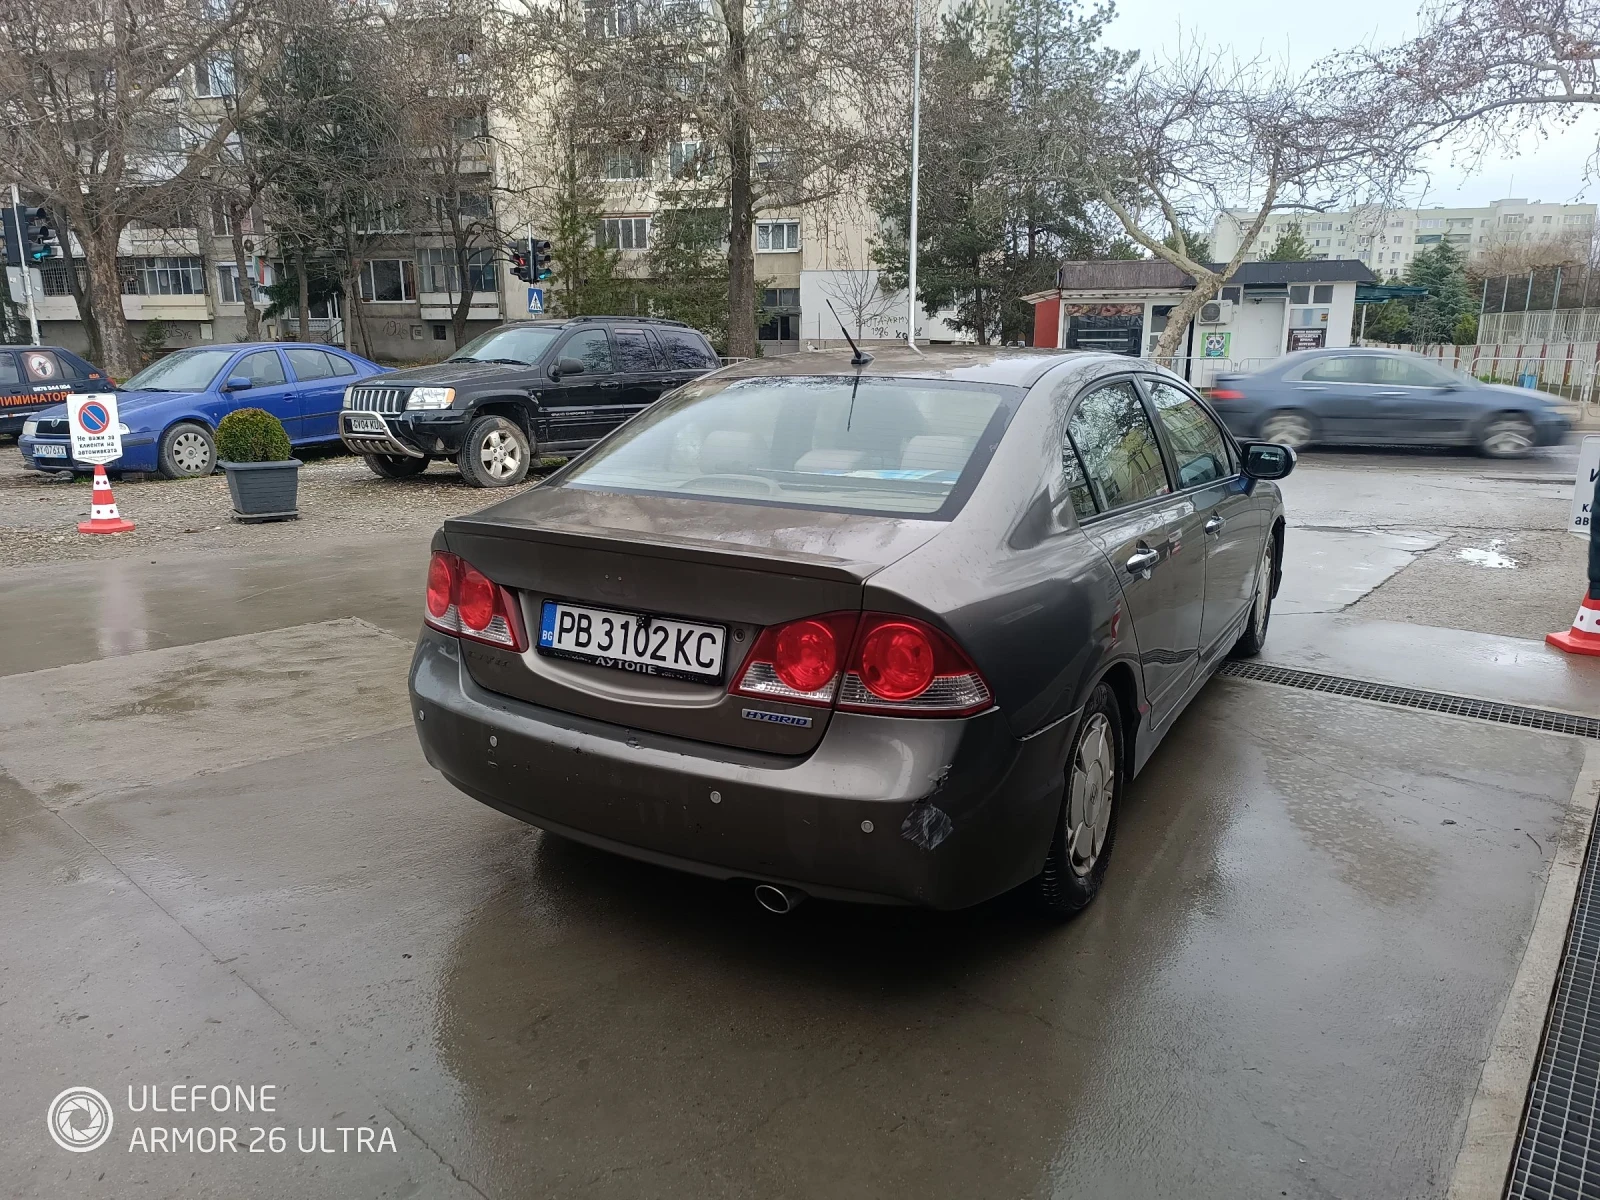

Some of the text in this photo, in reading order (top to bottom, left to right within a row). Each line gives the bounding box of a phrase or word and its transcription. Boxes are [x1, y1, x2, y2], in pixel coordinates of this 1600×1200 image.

[77, 448, 117, 456] автомивката
[542, 629, 554, 642] BG
[745, 711, 809, 726] HYBRID
